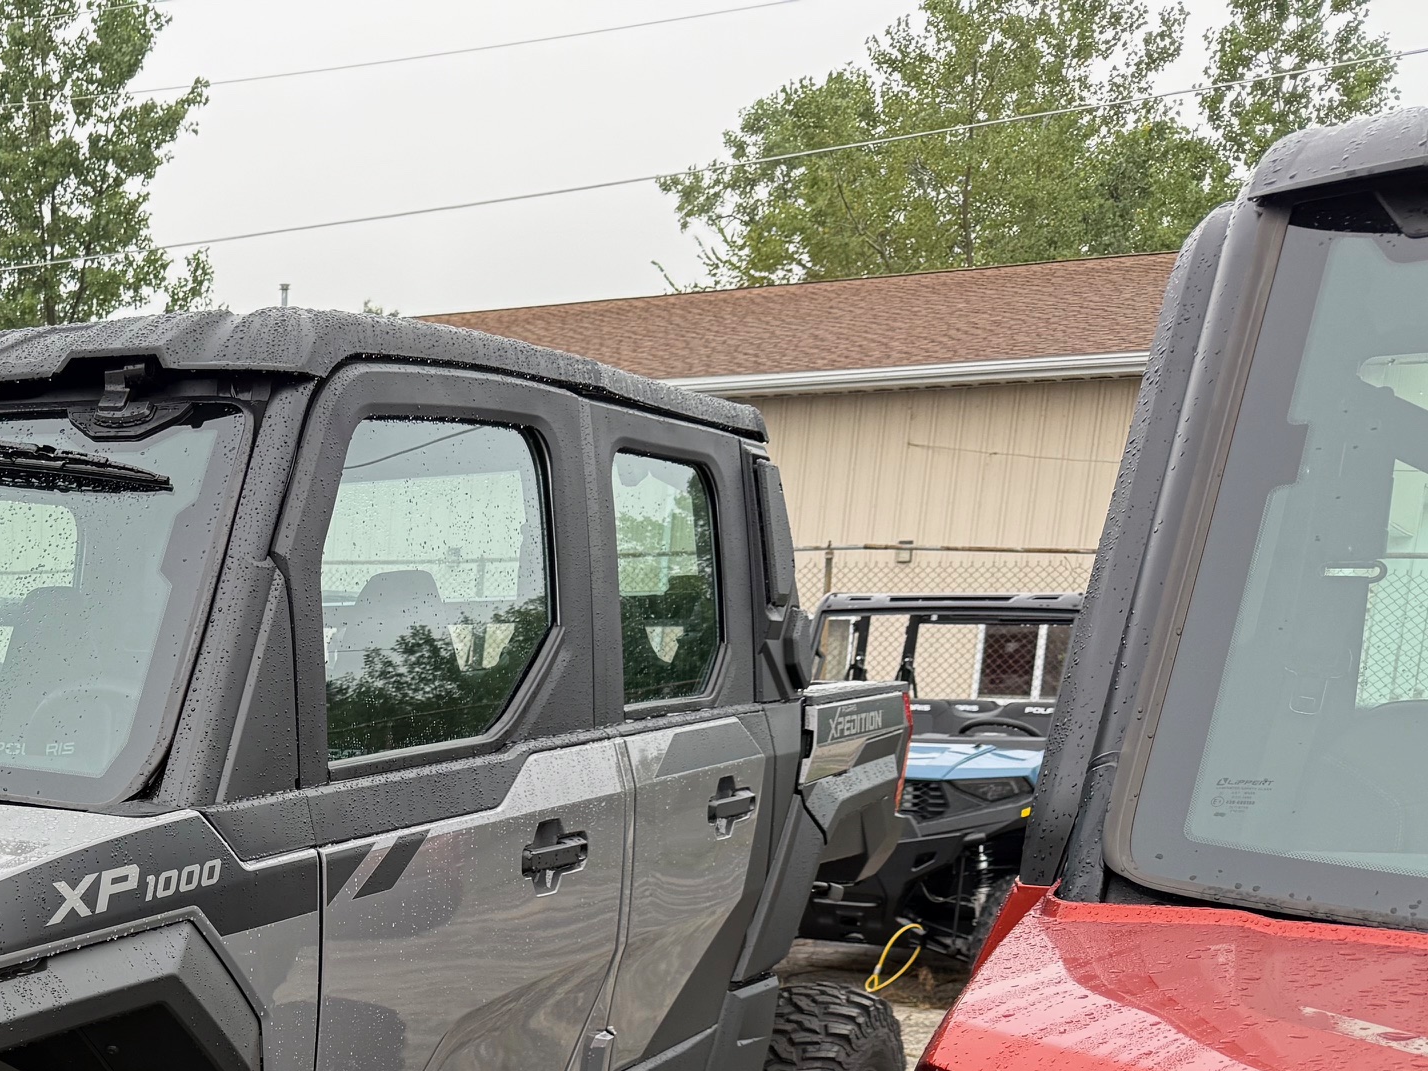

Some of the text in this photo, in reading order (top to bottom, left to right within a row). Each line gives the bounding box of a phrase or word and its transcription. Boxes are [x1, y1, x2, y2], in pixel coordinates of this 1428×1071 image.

[828, 706, 884, 743] XPEDITION
[45, 858, 222, 926] XP 1000
